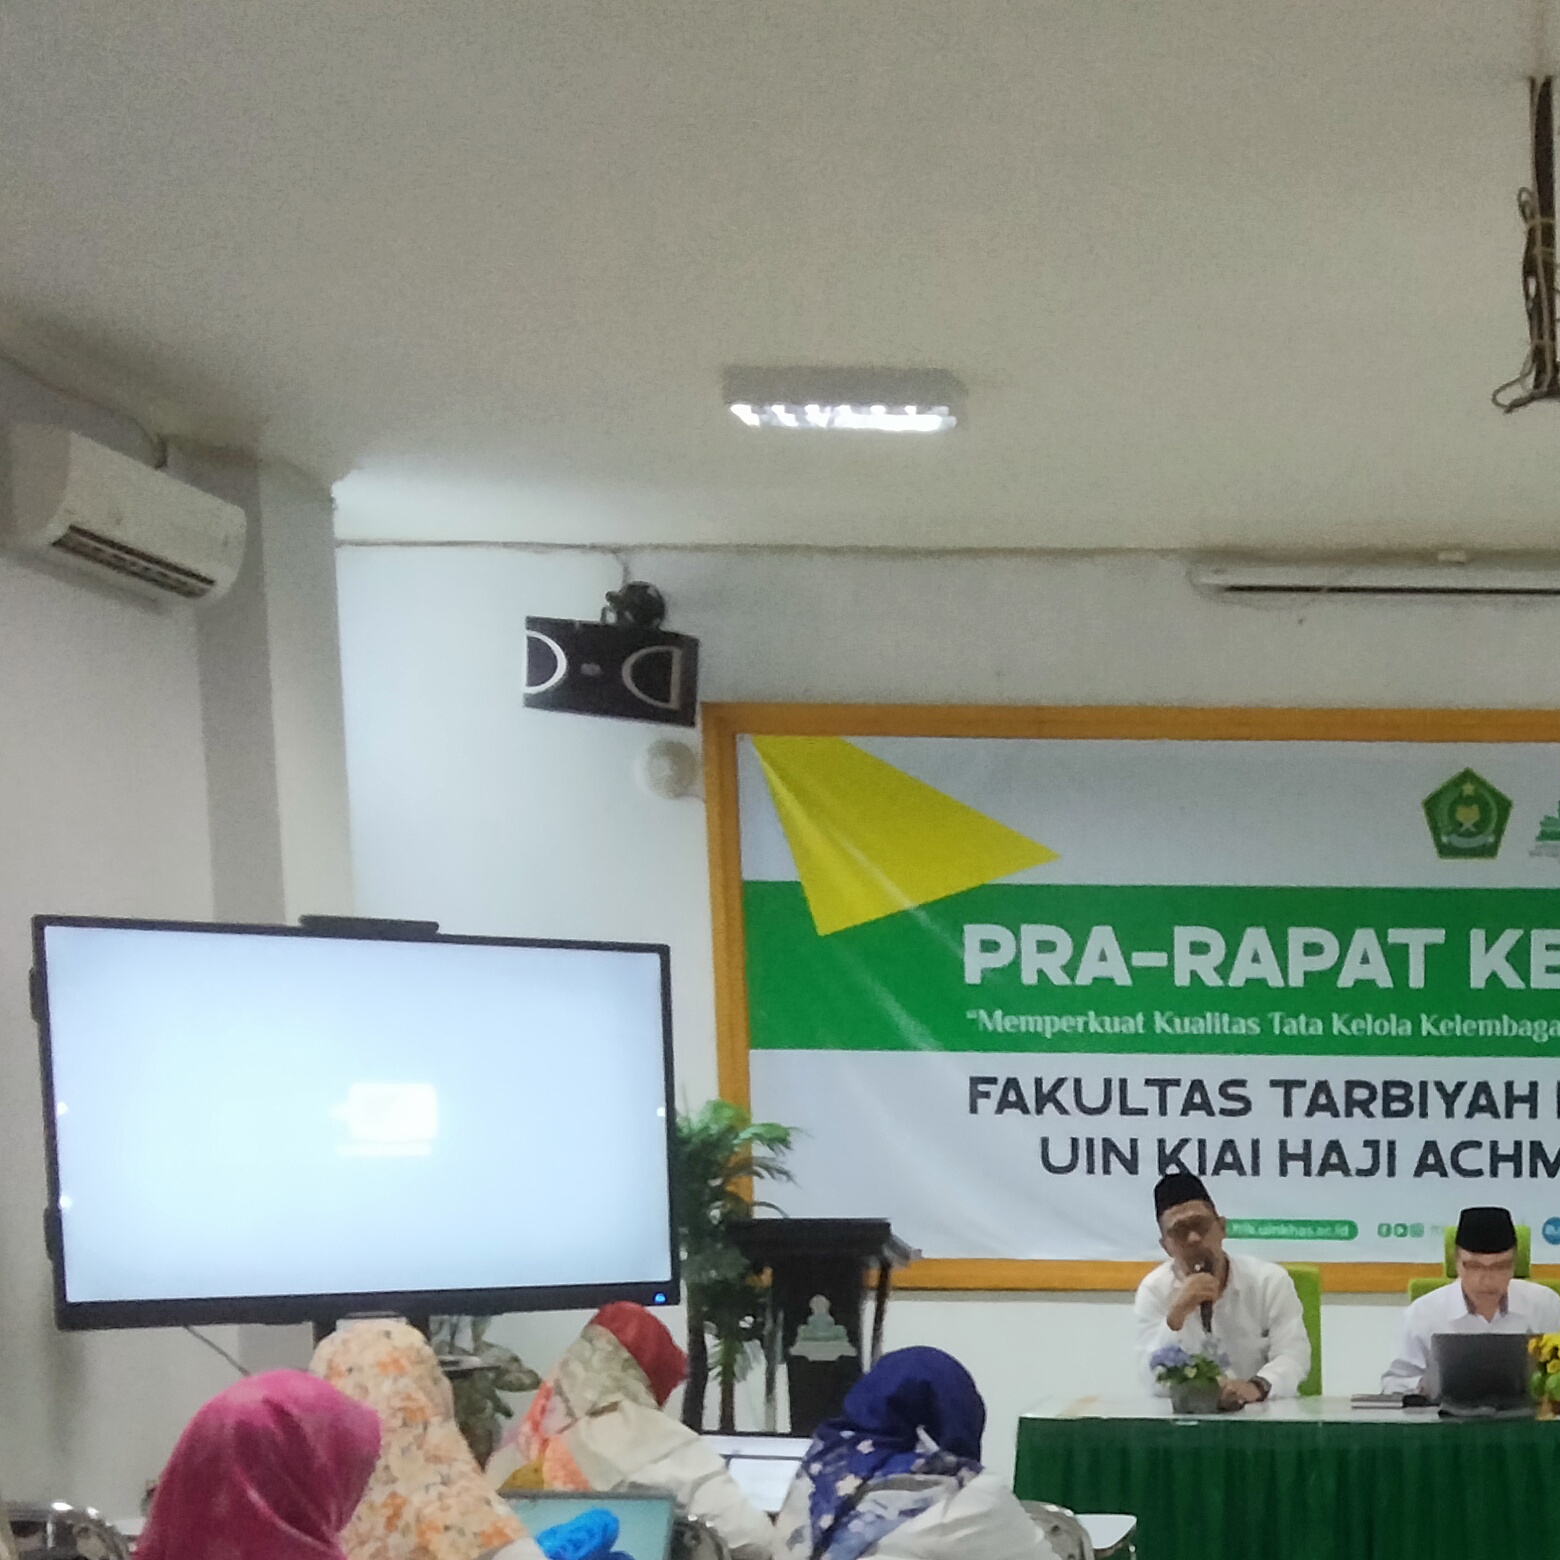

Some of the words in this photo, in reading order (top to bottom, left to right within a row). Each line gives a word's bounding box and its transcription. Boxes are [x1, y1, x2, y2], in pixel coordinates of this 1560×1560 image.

[962, 924, 1446, 989] PRA-RAPAT
[1153, 1010, 1261, 1035] Kualitas
[1268, 1011, 1324, 1036] Tata
[1331, 1012, 1412, 1037] Kelola
[968, 1076, 1253, 1118] FAKULTAS
[1269, 1078, 1539, 1120] TARBIYAH
[1040, 1136, 1139, 1176] UIN
[1156, 1137, 1261, 1177] KIAI
[1278, 1138, 1397, 1179] HAJI
